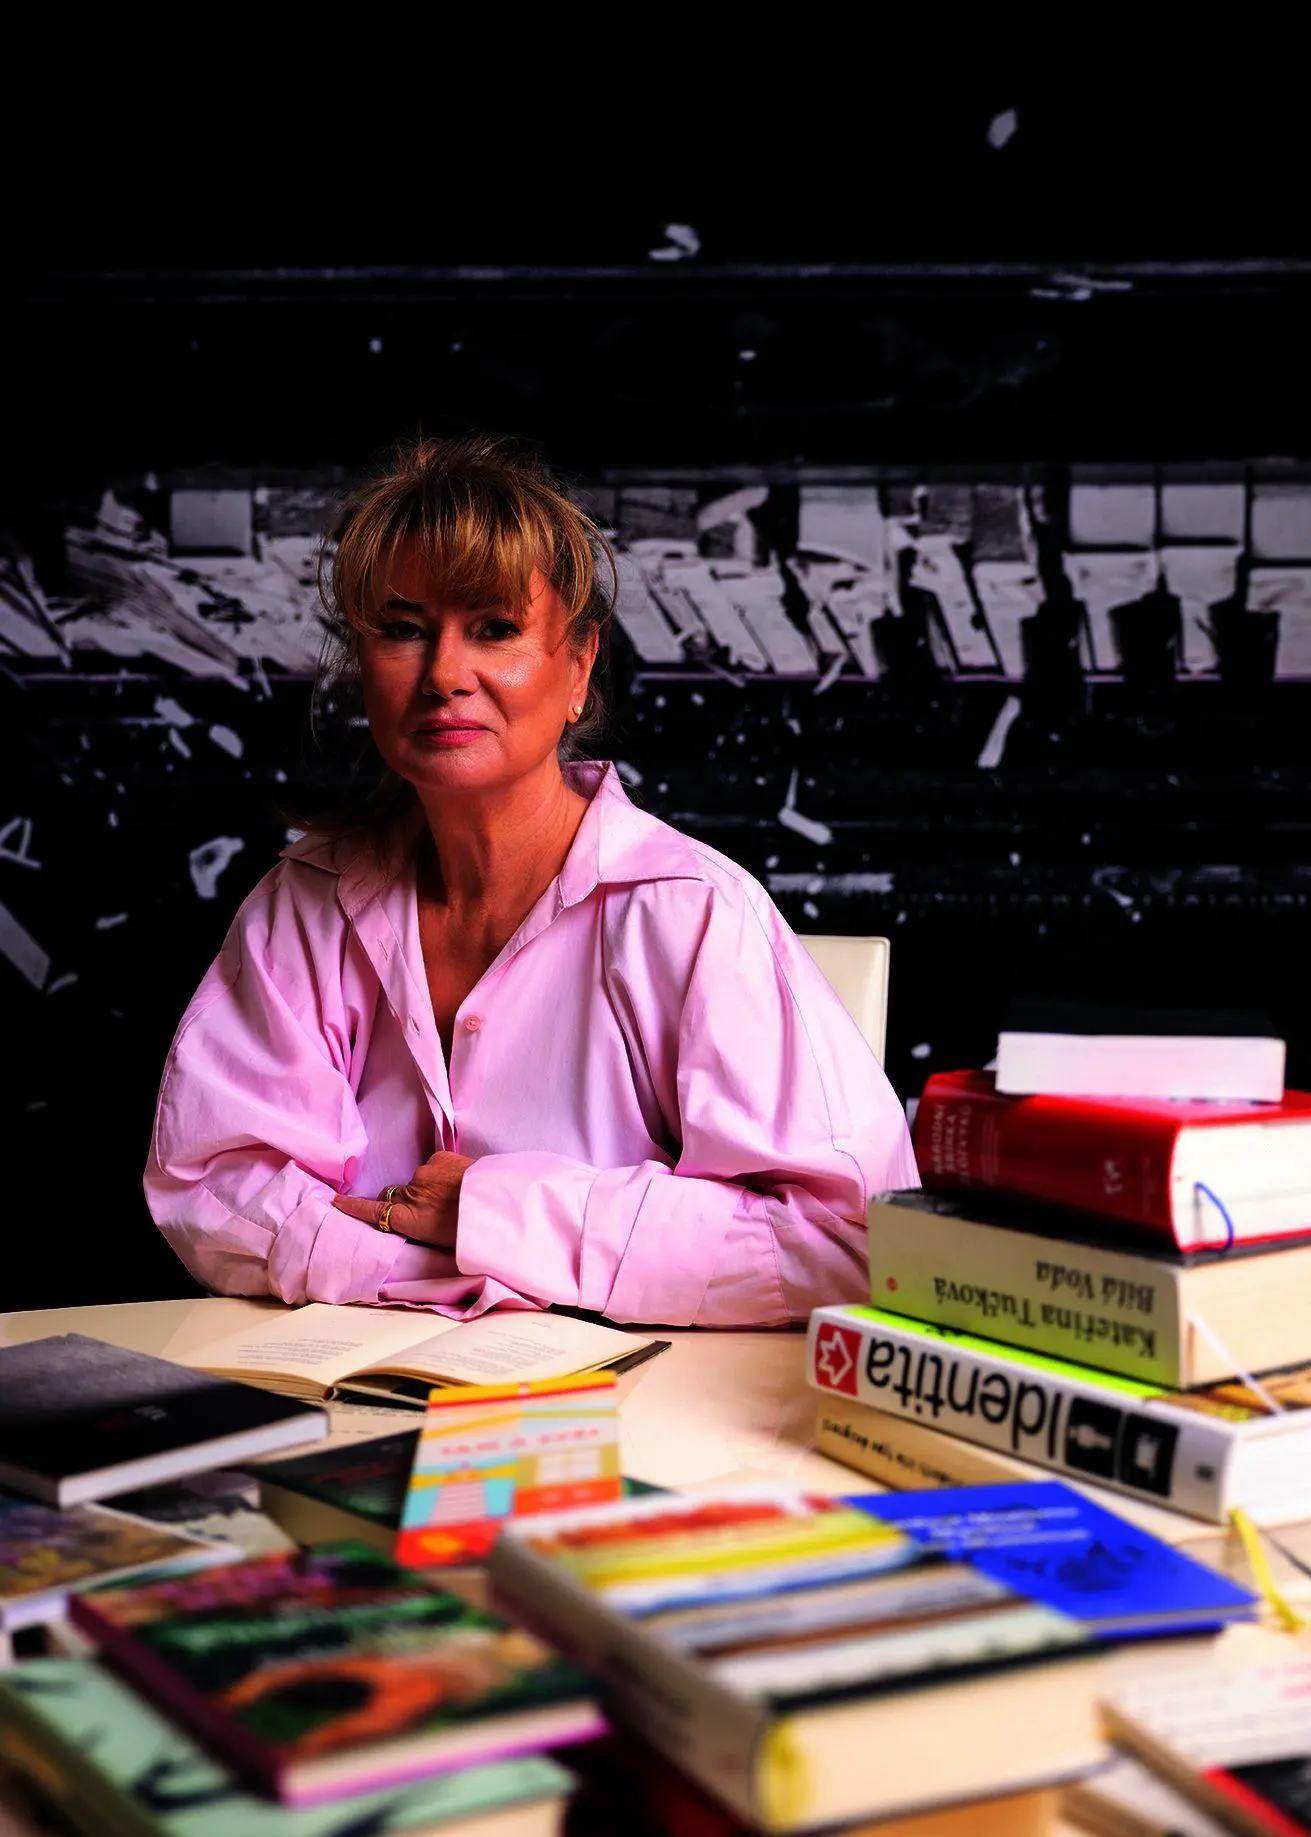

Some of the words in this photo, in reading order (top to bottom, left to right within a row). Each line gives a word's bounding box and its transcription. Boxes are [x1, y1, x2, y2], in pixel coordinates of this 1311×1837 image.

[933, 1276, 1037, 1328] Tučková
[1035, 1259, 1094, 1300] Voda
[1101, 1275, 1157, 1315] Bílá
[1040, 1302, 1156, 1359] Kateřina
[865, 1336, 1062, 1460] Identita
